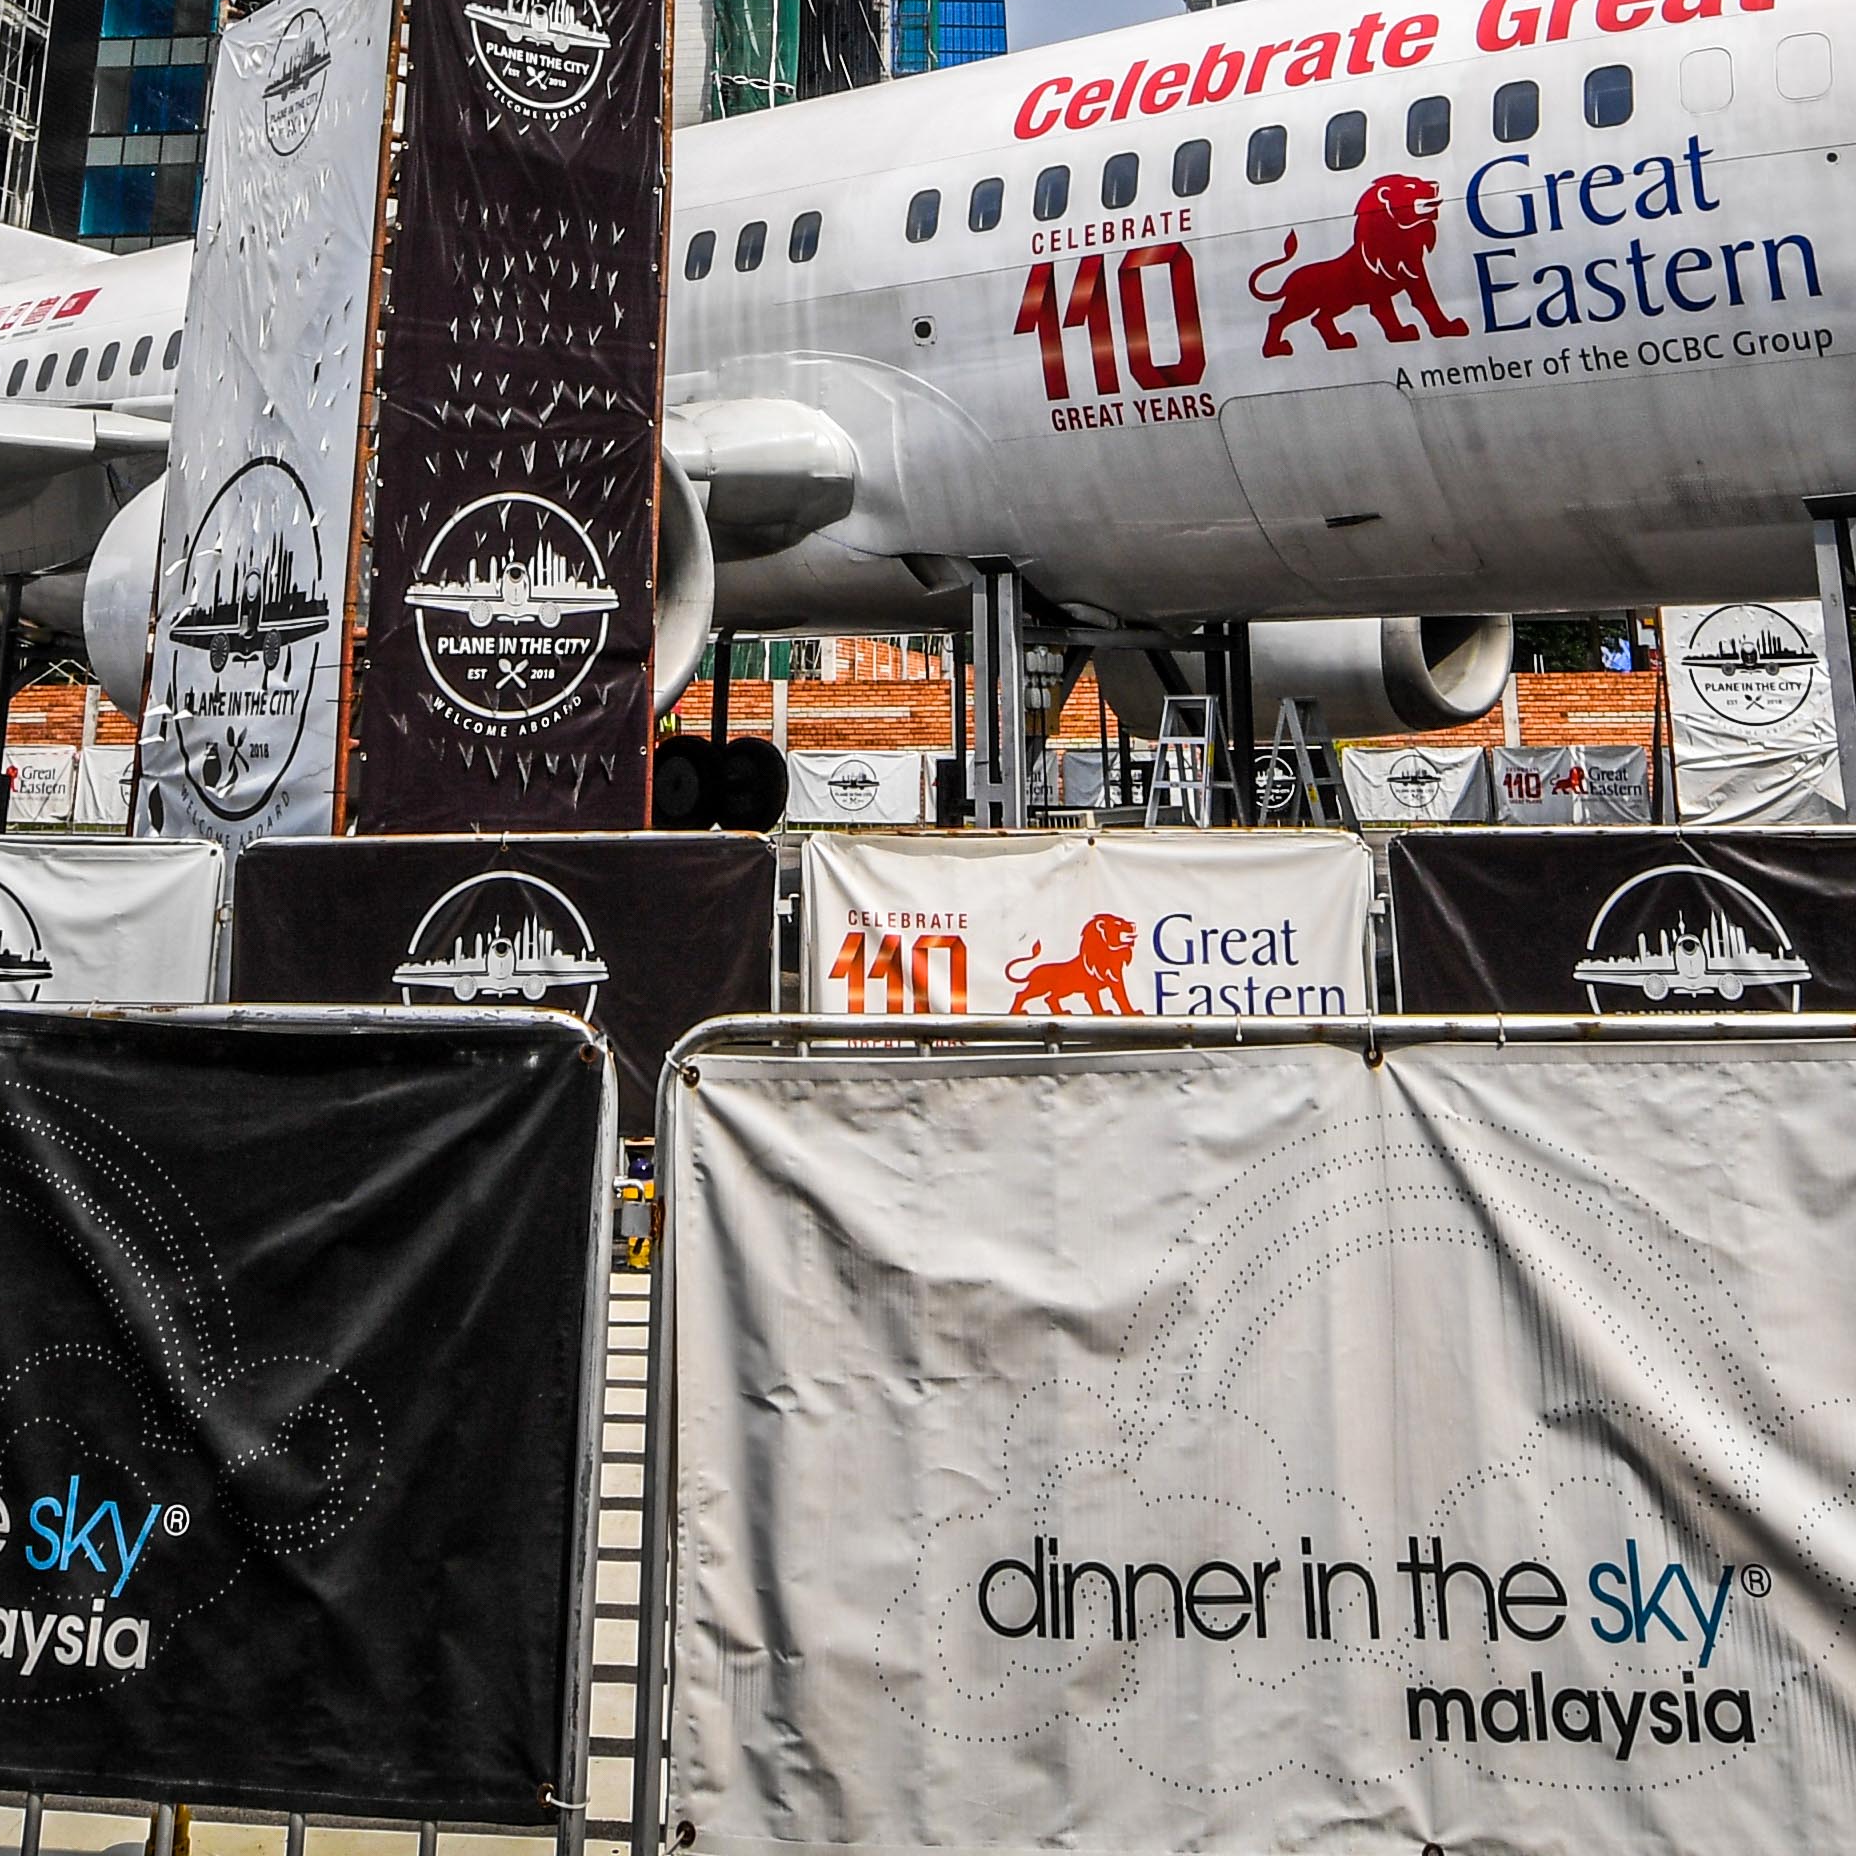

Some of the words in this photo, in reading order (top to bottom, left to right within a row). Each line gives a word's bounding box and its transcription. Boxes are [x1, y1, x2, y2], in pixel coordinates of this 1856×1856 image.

[486, 42, 524, 62] PLANE
[525, 52, 538, 65] IN
[539, 55, 562, 71] THE
[564, 60, 590, 75] CITY
[1013, 13, 1439, 141] Celebrate
[486, 81, 537, 119] WELCOME
[545, 101, 587, 120] ABOARD
[1467, 135, 1720, 239] Great
[1031, 207, 1193, 255] CELEBRATE
[1475, 234, 1824, 334] Eastern
[1013, 242, 1207, 401] 110
[1394, 367, 1414, 390] A
[1420, 355, 1533, 386] member
[1543, 347, 1570, 376] of
[1579, 343, 1628, 373] the
[1637, 333, 1725, 367] OCBC
[1733, 325, 1834, 360] Group
[1051, 401, 1125, 433] GREAT
[1135, 392, 1216, 425] YEARS
[438, 637, 494, 655] PLANE
[499, 638, 516, 655] IN
[520, 638, 552, 655] THE
[554, 638, 590, 655] CITY
[467, 668, 488, 679] EST
[530, 668, 555, 679] 2018
[1705, 682, 1740, 692] PLANE
[1742, 682, 1753, 692] IN
[1756, 682, 1776, 692] THE
[1778, 681, 1802, 691] CITY
[228, 691, 242, 716] IN
[245, 691, 267, 716] THE
[270, 689, 299, 716] CITY
[433, 696, 508, 737] WELCOME
[250, 744, 269, 758] 2018
[20, 780, 66, 794] Eastern
[22, 766, 55, 780] Great
[1503, 773, 1541, 798] 110
[1588, 766, 1628, 781] Great
[1590, 781, 1642, 796] Eastern
[848, 909, 968, 929] CELEBRATE
[1152, 913, 1299, 966] Great
[1154, 971, 1345, 1015] Eastern
[978, 1536, 1281, 1641] dinner
[1300, 1536, 1381, 1641] in
[1396, 1536, 1569, 1642] the
[1406, 1670, 1757, 1763] malaysia
